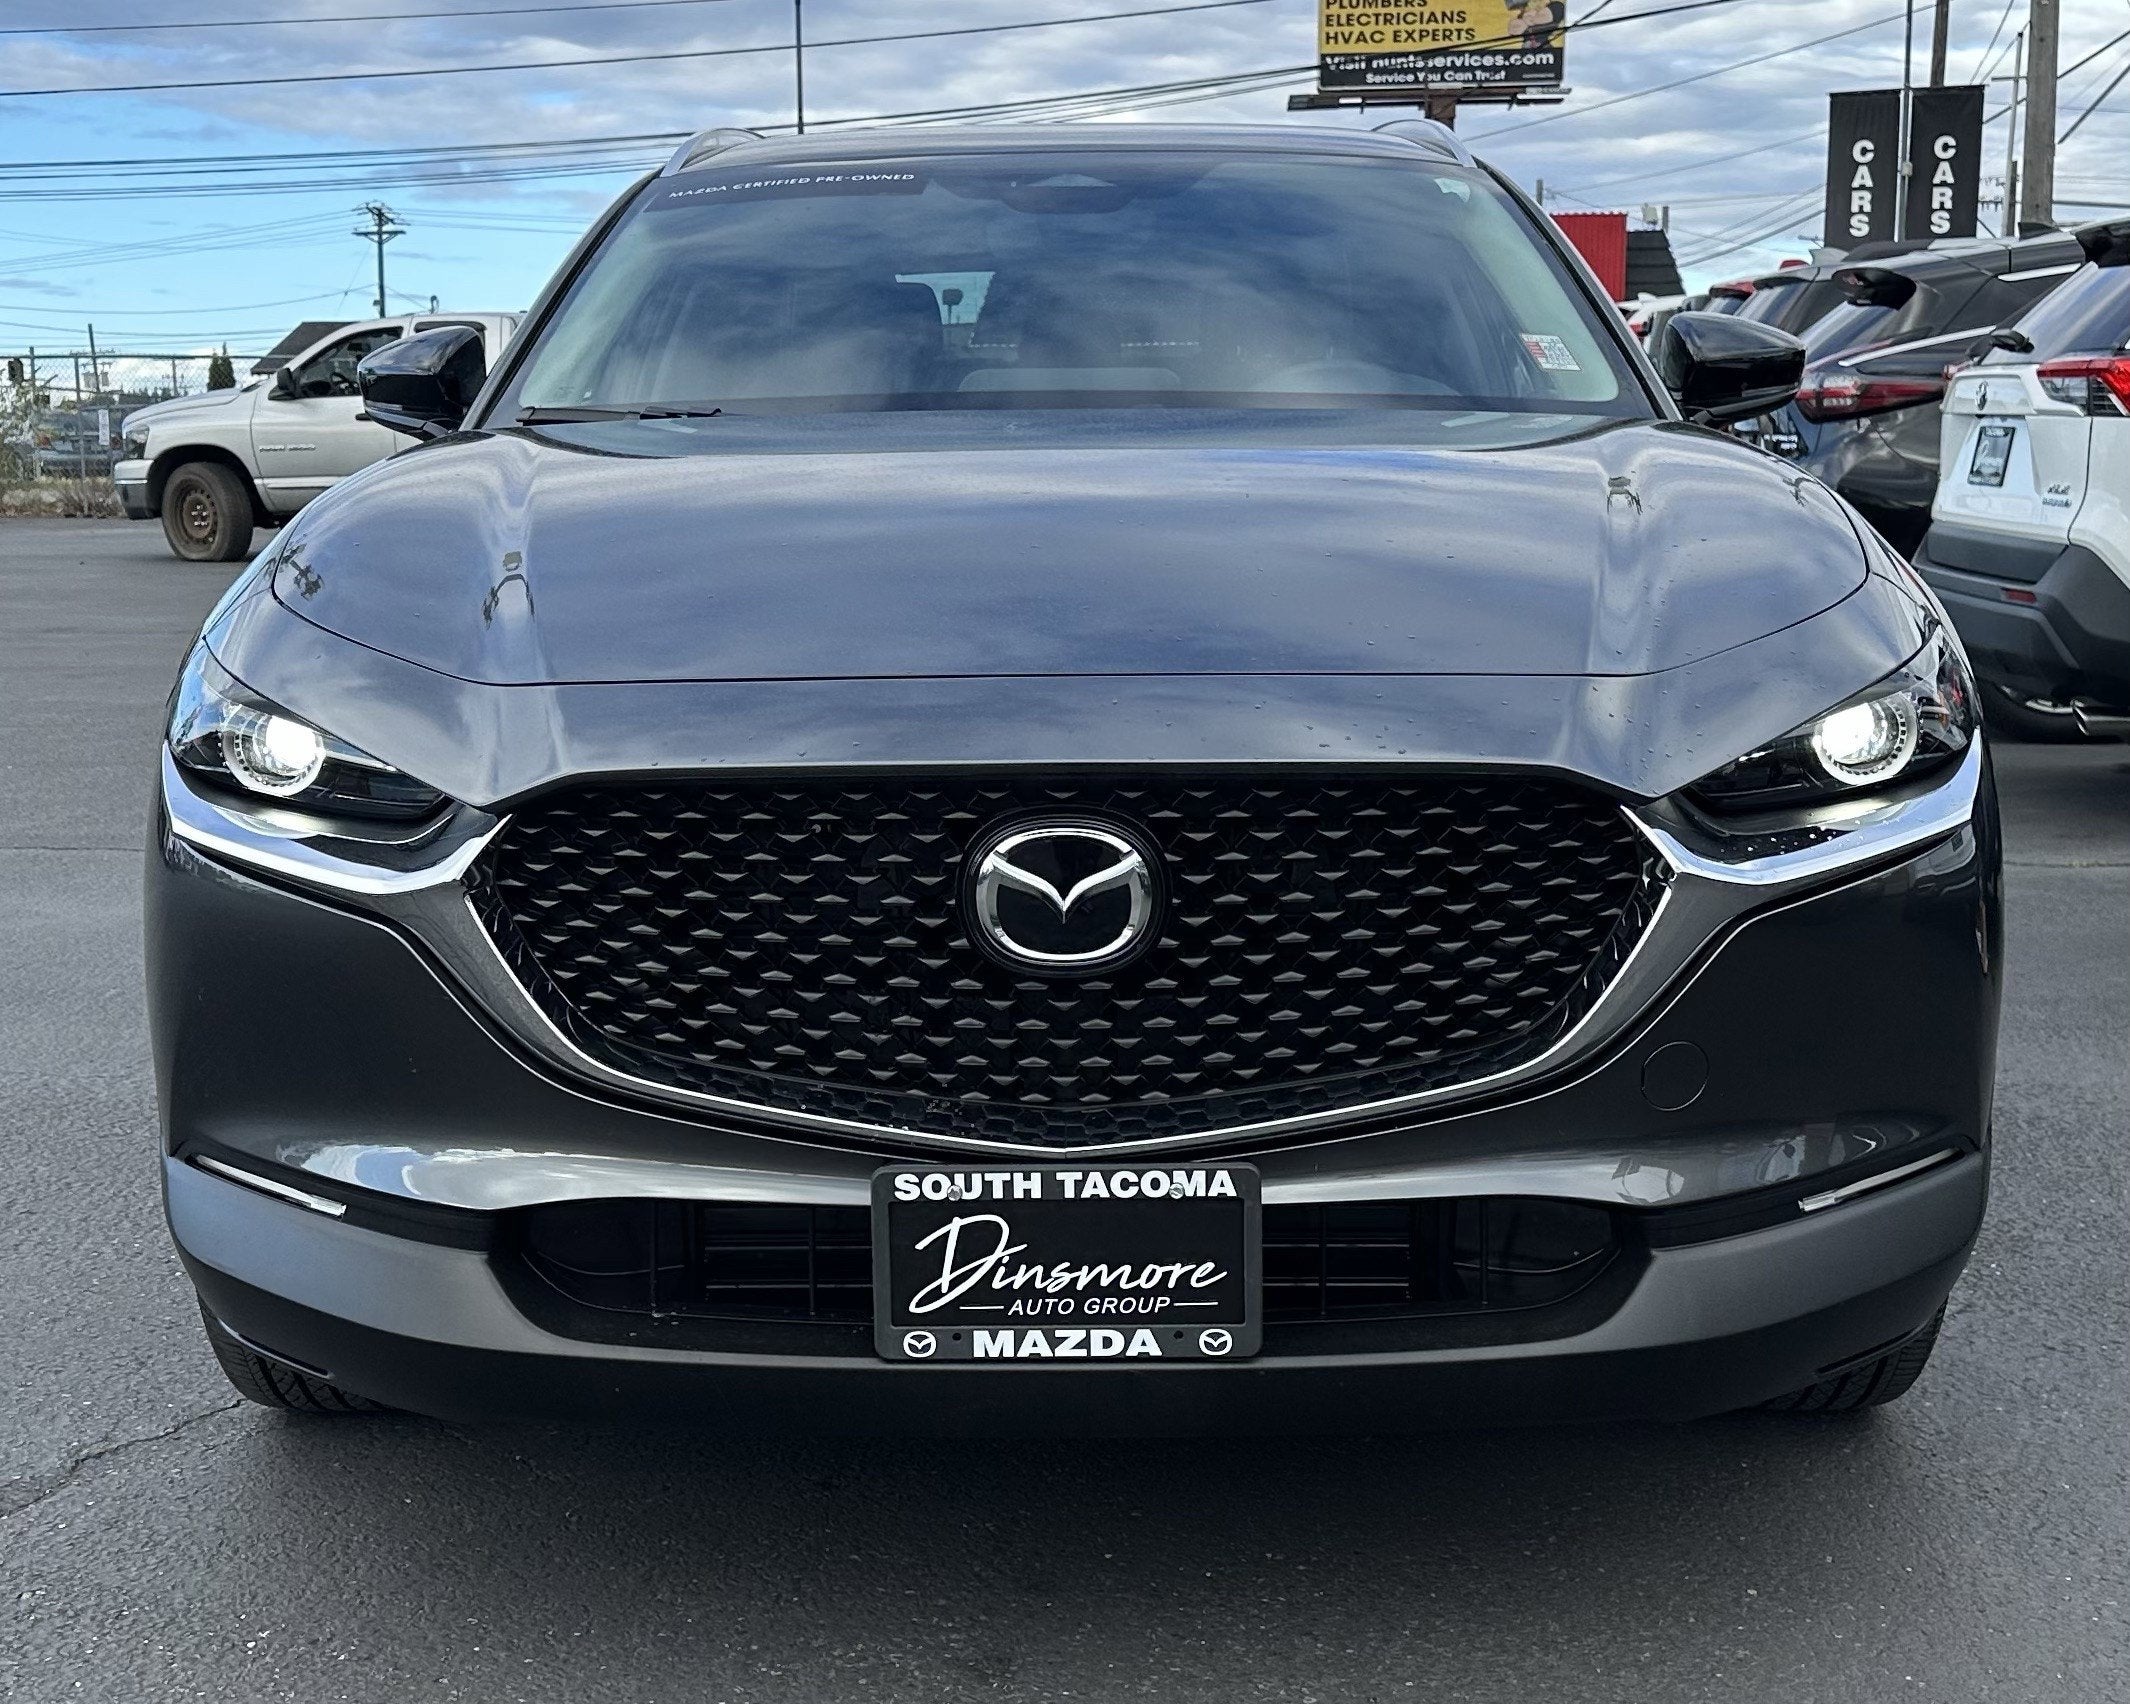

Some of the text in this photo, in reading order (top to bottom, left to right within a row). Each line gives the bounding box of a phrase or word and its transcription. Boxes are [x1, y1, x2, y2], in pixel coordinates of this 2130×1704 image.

[1326, 0, 1428, 9] PLUMBERS
[1325, 10, 1467, 27] ELECTRICIANS
[1325, 27, 1476, 45] HVAC EXPERTS
[1365, 72, 1415, 84] Service
[1443, 70, 1473, 81] Can
[668, 173, 915, 198] MAZDA CERTIFIED PRE-OWNED
[1849, 138, 1875, 238] CARS
[1929, 134, 1957, 234] CARS
[893, 1169, 1237, 1202] SOUTH TACOMA
[908, 1213, 1227, 1314] Dinsmore
[1008, 1296, 1171, 1316] AUTO GROUP
[972, 1328, 1163, 1358] MAZDA
